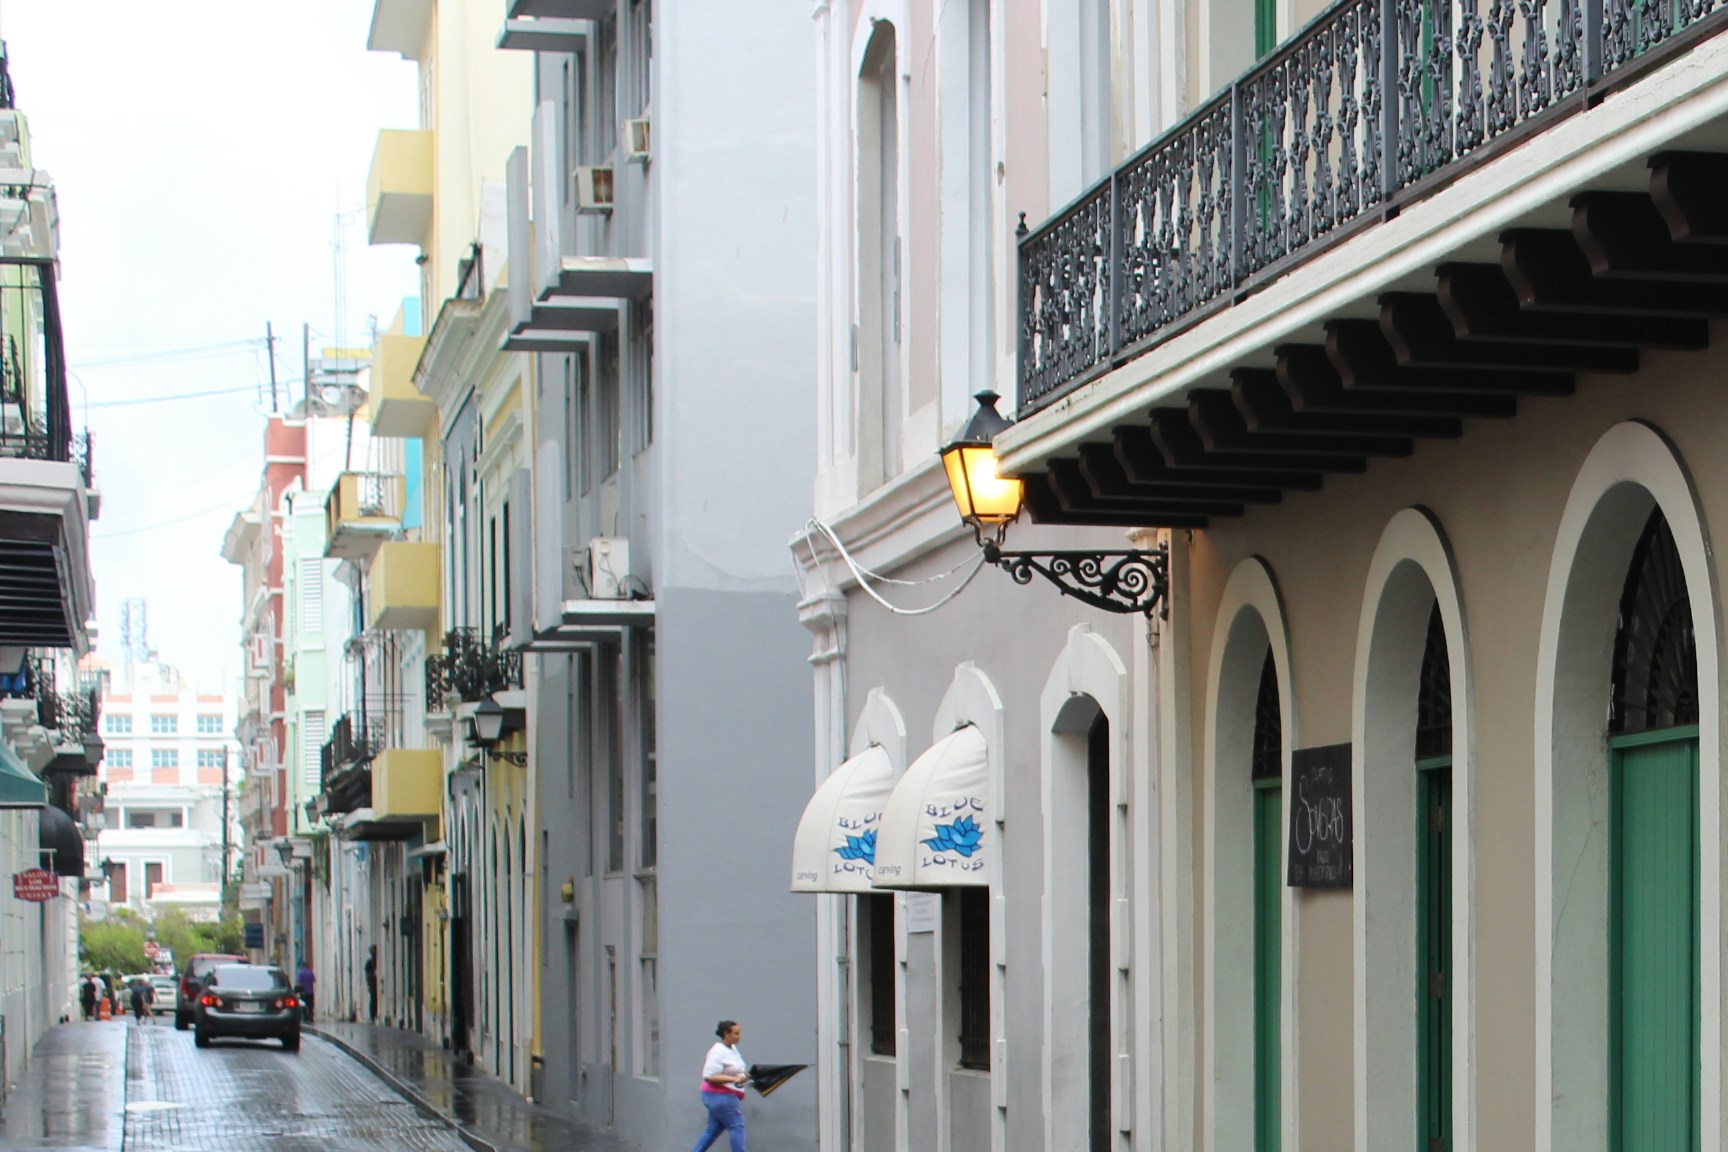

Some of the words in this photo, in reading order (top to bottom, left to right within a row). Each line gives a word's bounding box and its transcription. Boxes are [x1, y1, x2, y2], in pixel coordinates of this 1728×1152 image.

[925, 797, 984, 817] BLUE
[837, 812, 882, 829] BLU
[878, 864, 901, 876] carving
[921, 854, 984, 872] LOTUS
[797, 871, 818, 882] carving
